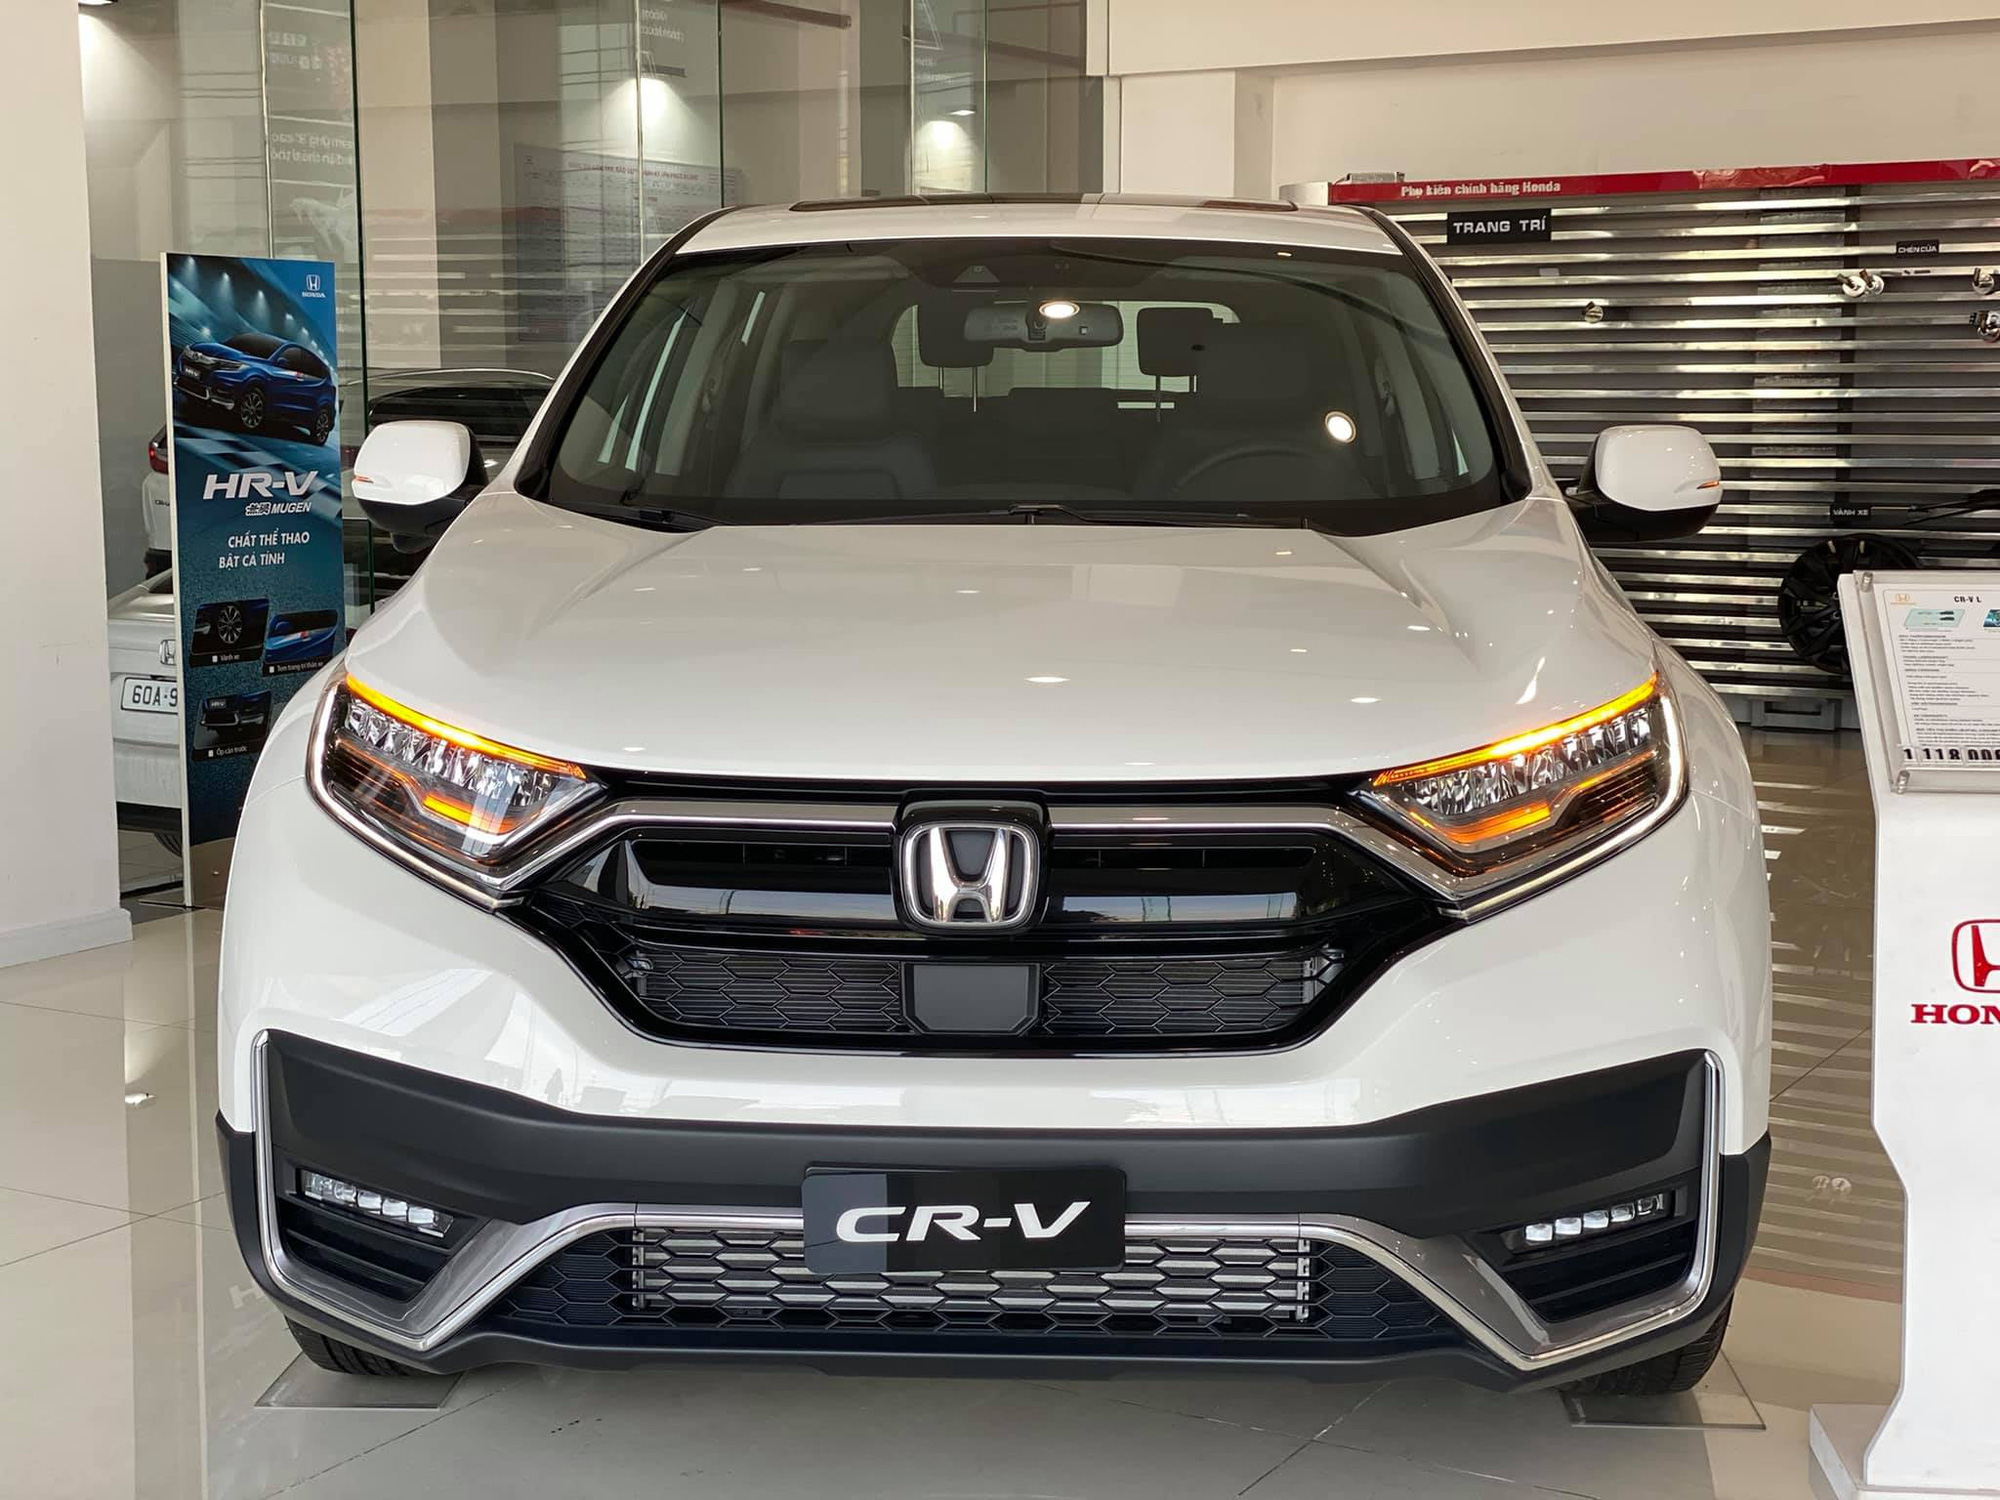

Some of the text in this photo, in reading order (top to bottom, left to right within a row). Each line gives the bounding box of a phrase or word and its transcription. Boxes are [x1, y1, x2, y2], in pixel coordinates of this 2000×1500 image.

[1401, 185, 1423, 199] Phụ
[1455, 183, 1487, 195] chính
[1490, 181, 1520, 196] hãng
[1522, 181, 1561, 193] Honda
[1453, 215, 1546, 234] TRANG TRÍ
[203, 471, 318, 499] HR-V
[271, 502, 312, 514] MUGEN
[228, 527, 310, 548] CHẤT THỂ THAO
[218, 550, 285, 571] BẬT CÁ TÍNH
[1977, 595, 1982, 603] L
[1903, 748, 1913, 760] 1
[1922, 748, 1961, 761] 118
[836, 1201, 1091, 1243] CR-V
